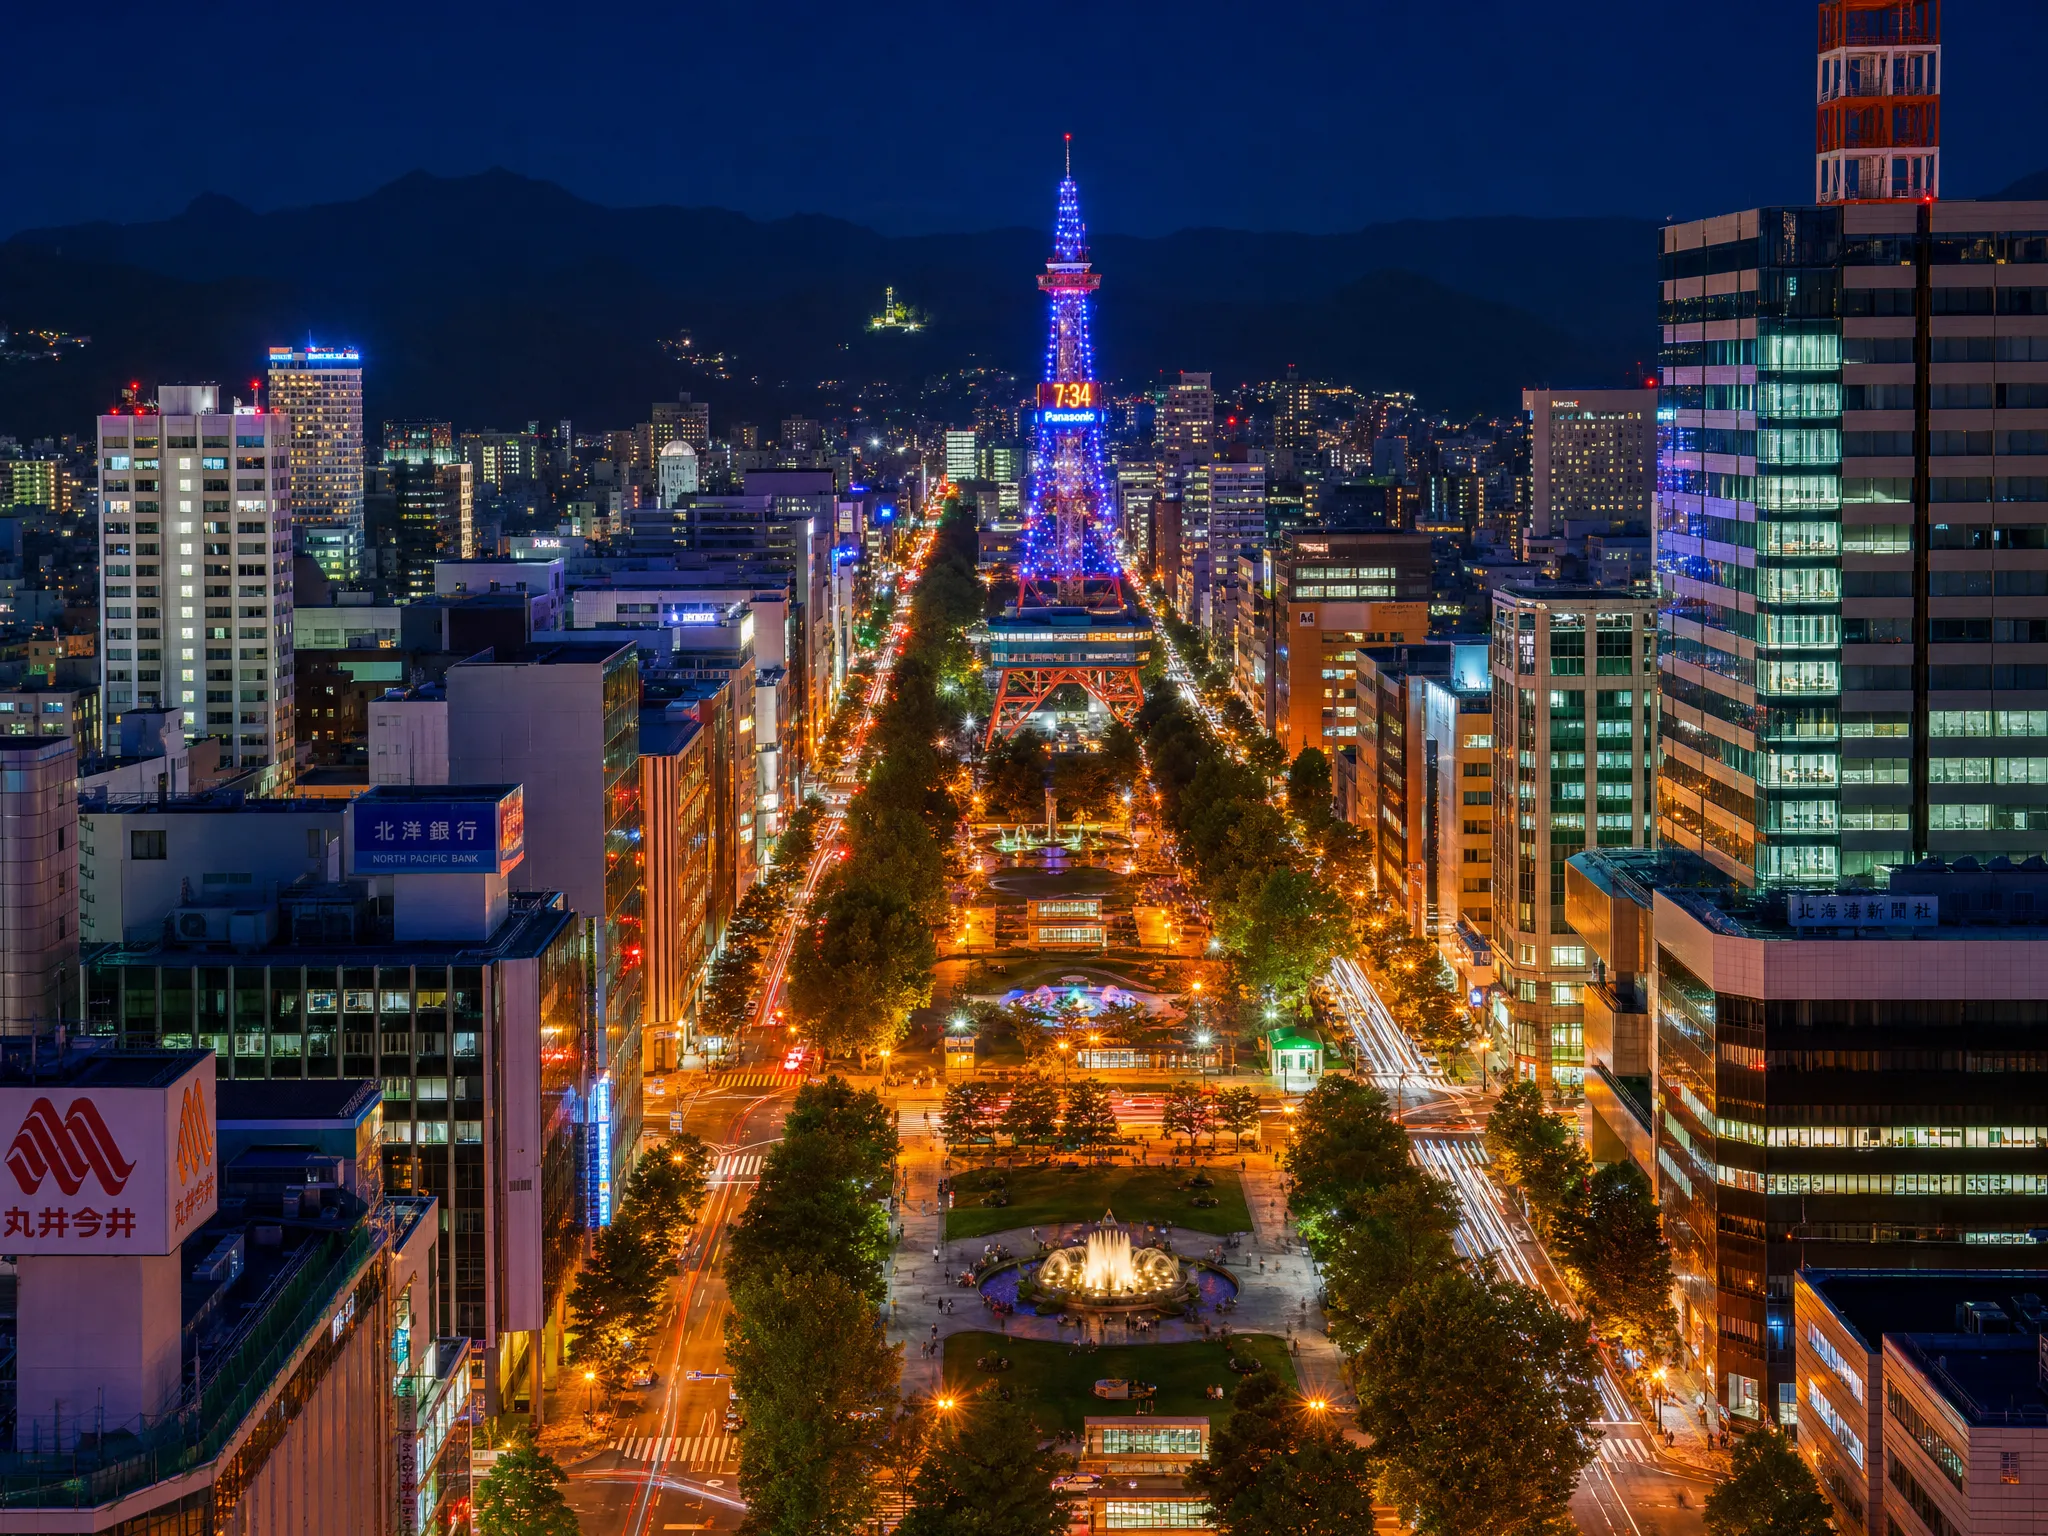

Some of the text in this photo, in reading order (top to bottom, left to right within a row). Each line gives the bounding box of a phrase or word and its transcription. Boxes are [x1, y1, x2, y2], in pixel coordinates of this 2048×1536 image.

[1053, 383, 1091, 409] 7:34
[1045, 411, 1095, 422] Panasonic
[374, 820, 477, 841] 北洋銀行
[373, 854, 479, 864] NORTH PACIFIC BANK
[174, 1171, 215, 1232] 丸井今井
[3, 1206, 137, 1238] 丸井今井
